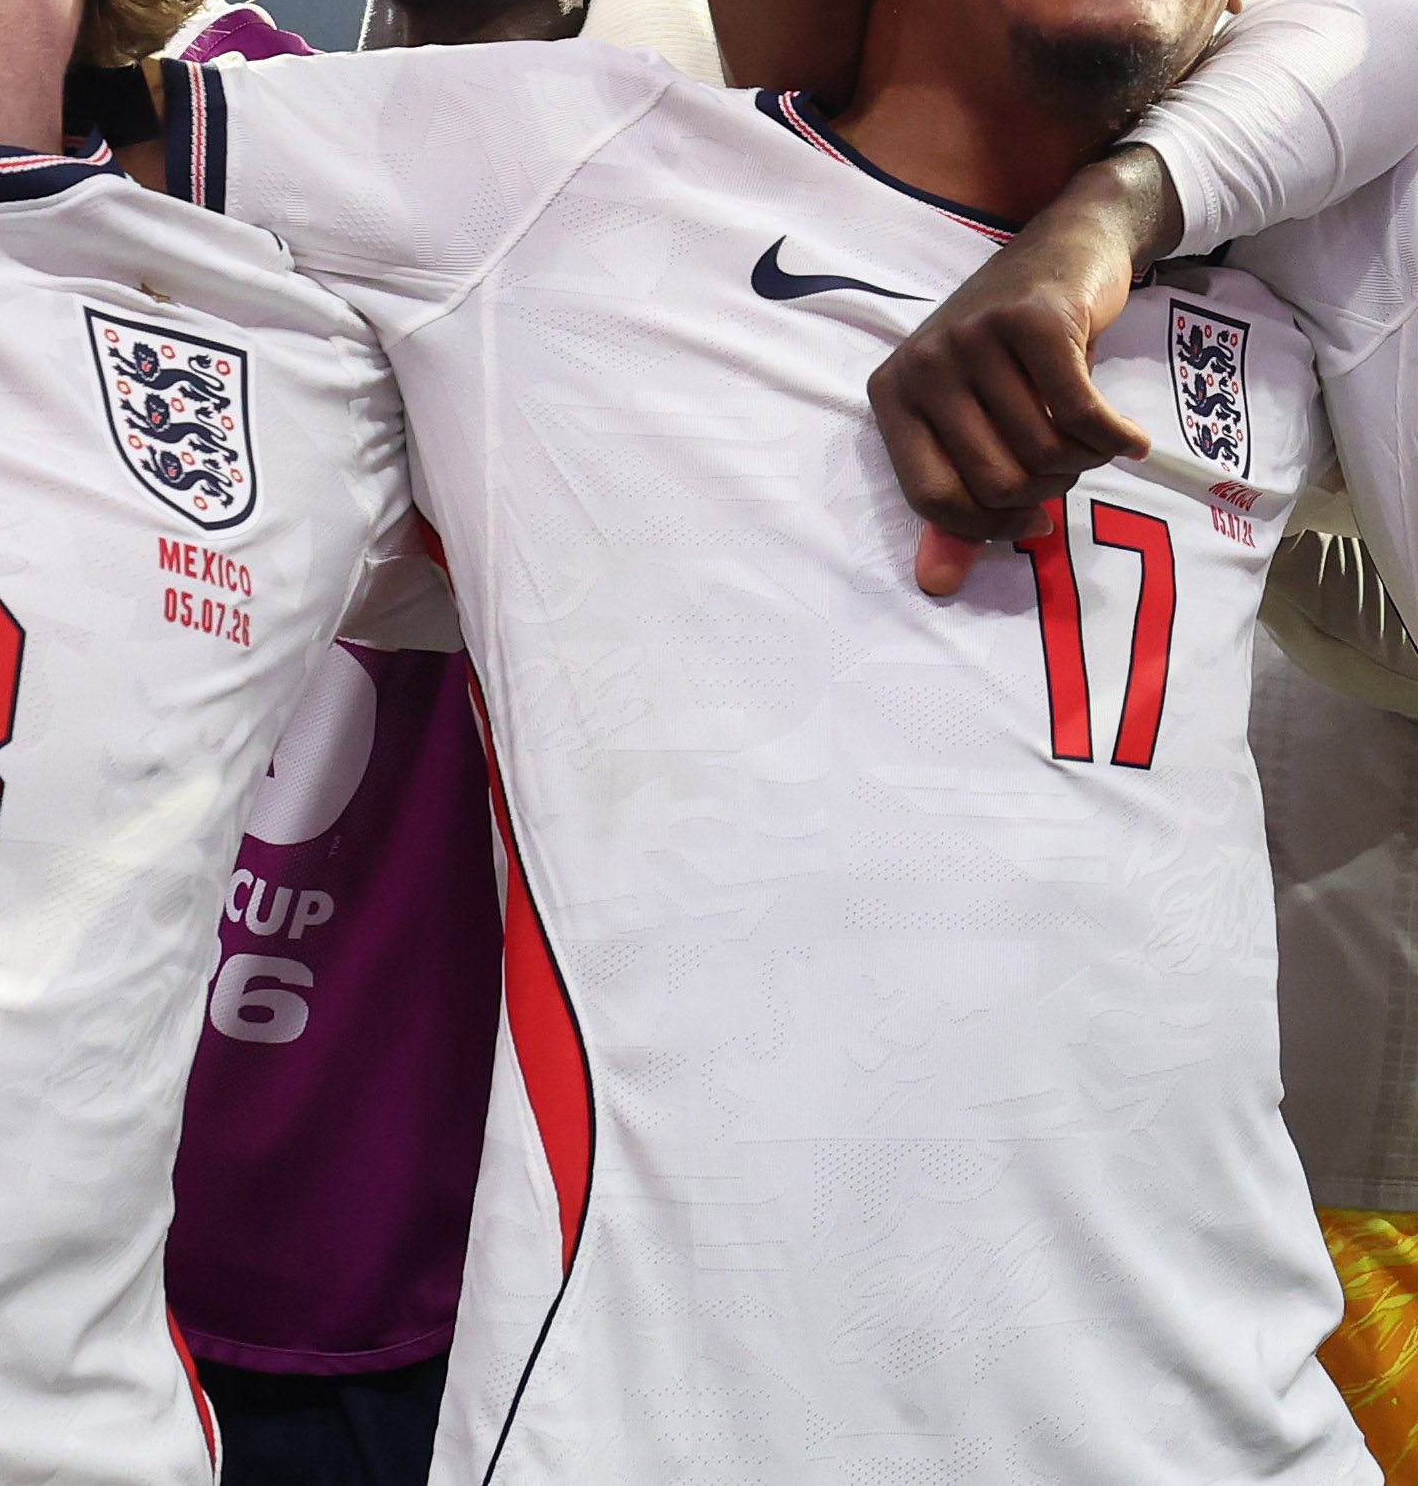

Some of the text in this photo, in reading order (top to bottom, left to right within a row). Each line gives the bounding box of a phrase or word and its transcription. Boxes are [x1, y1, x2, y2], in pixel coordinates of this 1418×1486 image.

[158, 536, 251, 597] MEXICO
[164, 587, 250, 647] 05.07.26
[1013, 490, 1177, 771] 17
[225, 868, 335, 940] CUP
[208, 939, 314, 1044] 6
